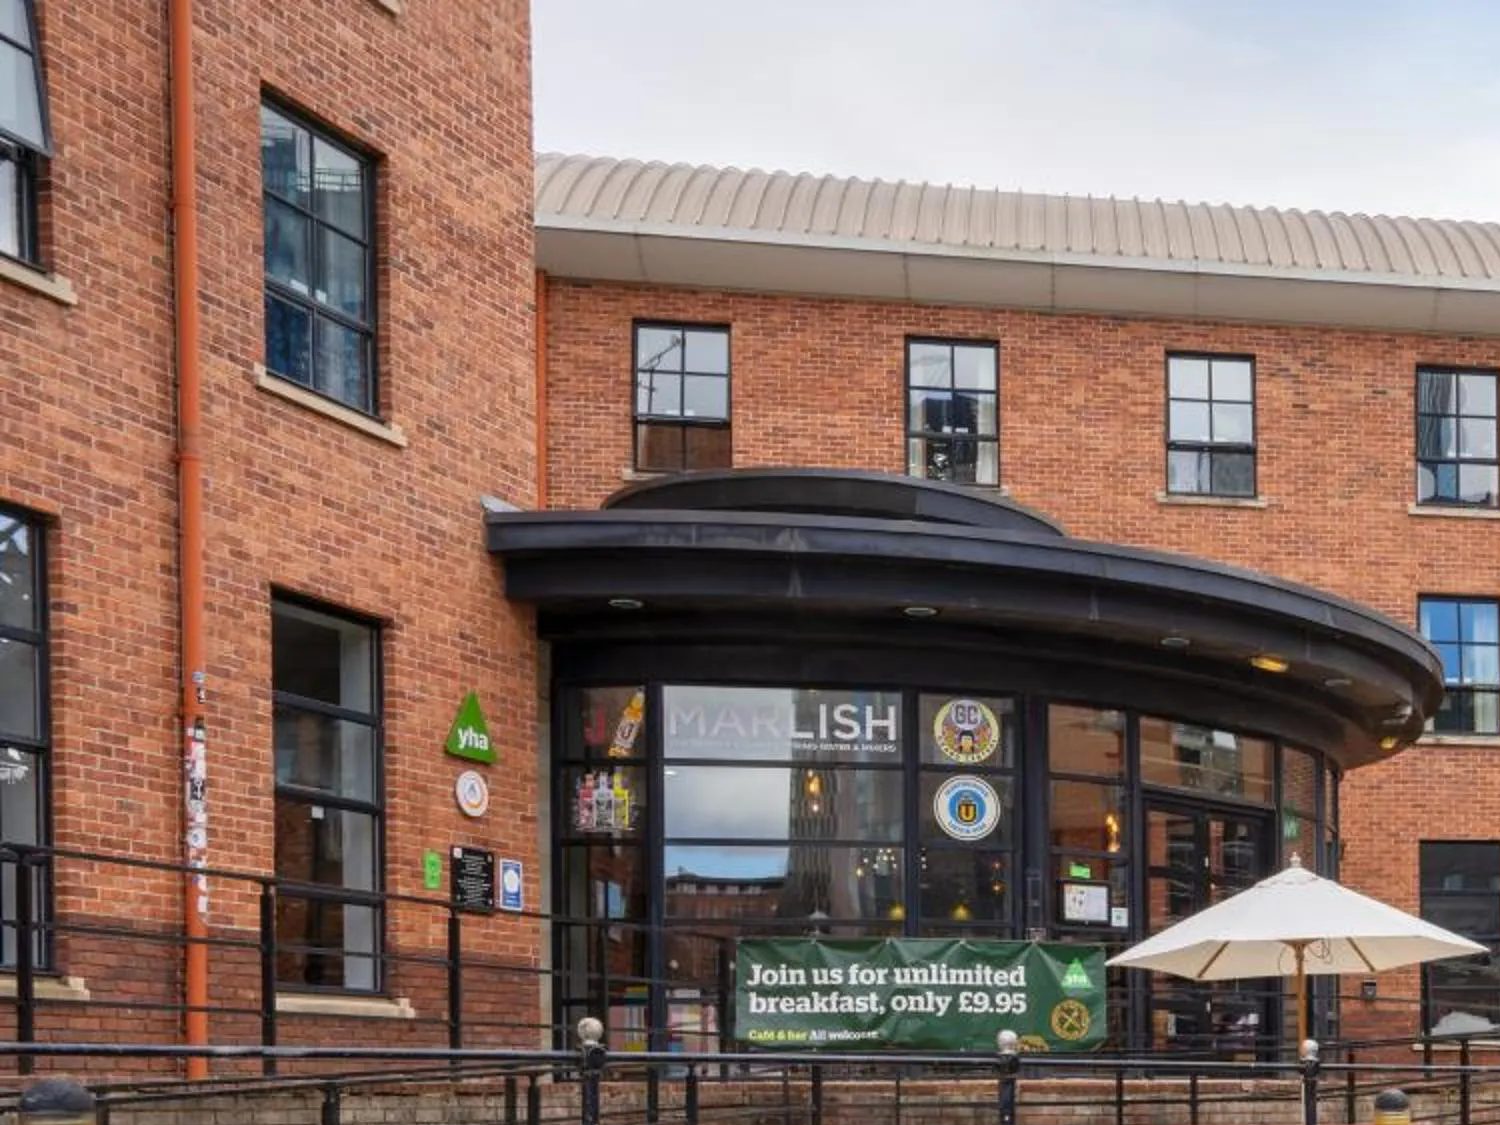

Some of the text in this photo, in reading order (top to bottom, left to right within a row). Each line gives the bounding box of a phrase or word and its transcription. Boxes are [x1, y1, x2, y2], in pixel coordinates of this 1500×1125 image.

[670, 703, 897, 741] MARLISH
[955, 704, 978, 725] GC
[457, 726, 489, 750] yha
[747, 963, 1027, 987] Join us for unlimited
[748, 991, 1028, 1017] breakfast, only £9.95
[787, 1029, 808, 1041] bar
[809, 1029, 827, 1041] All
